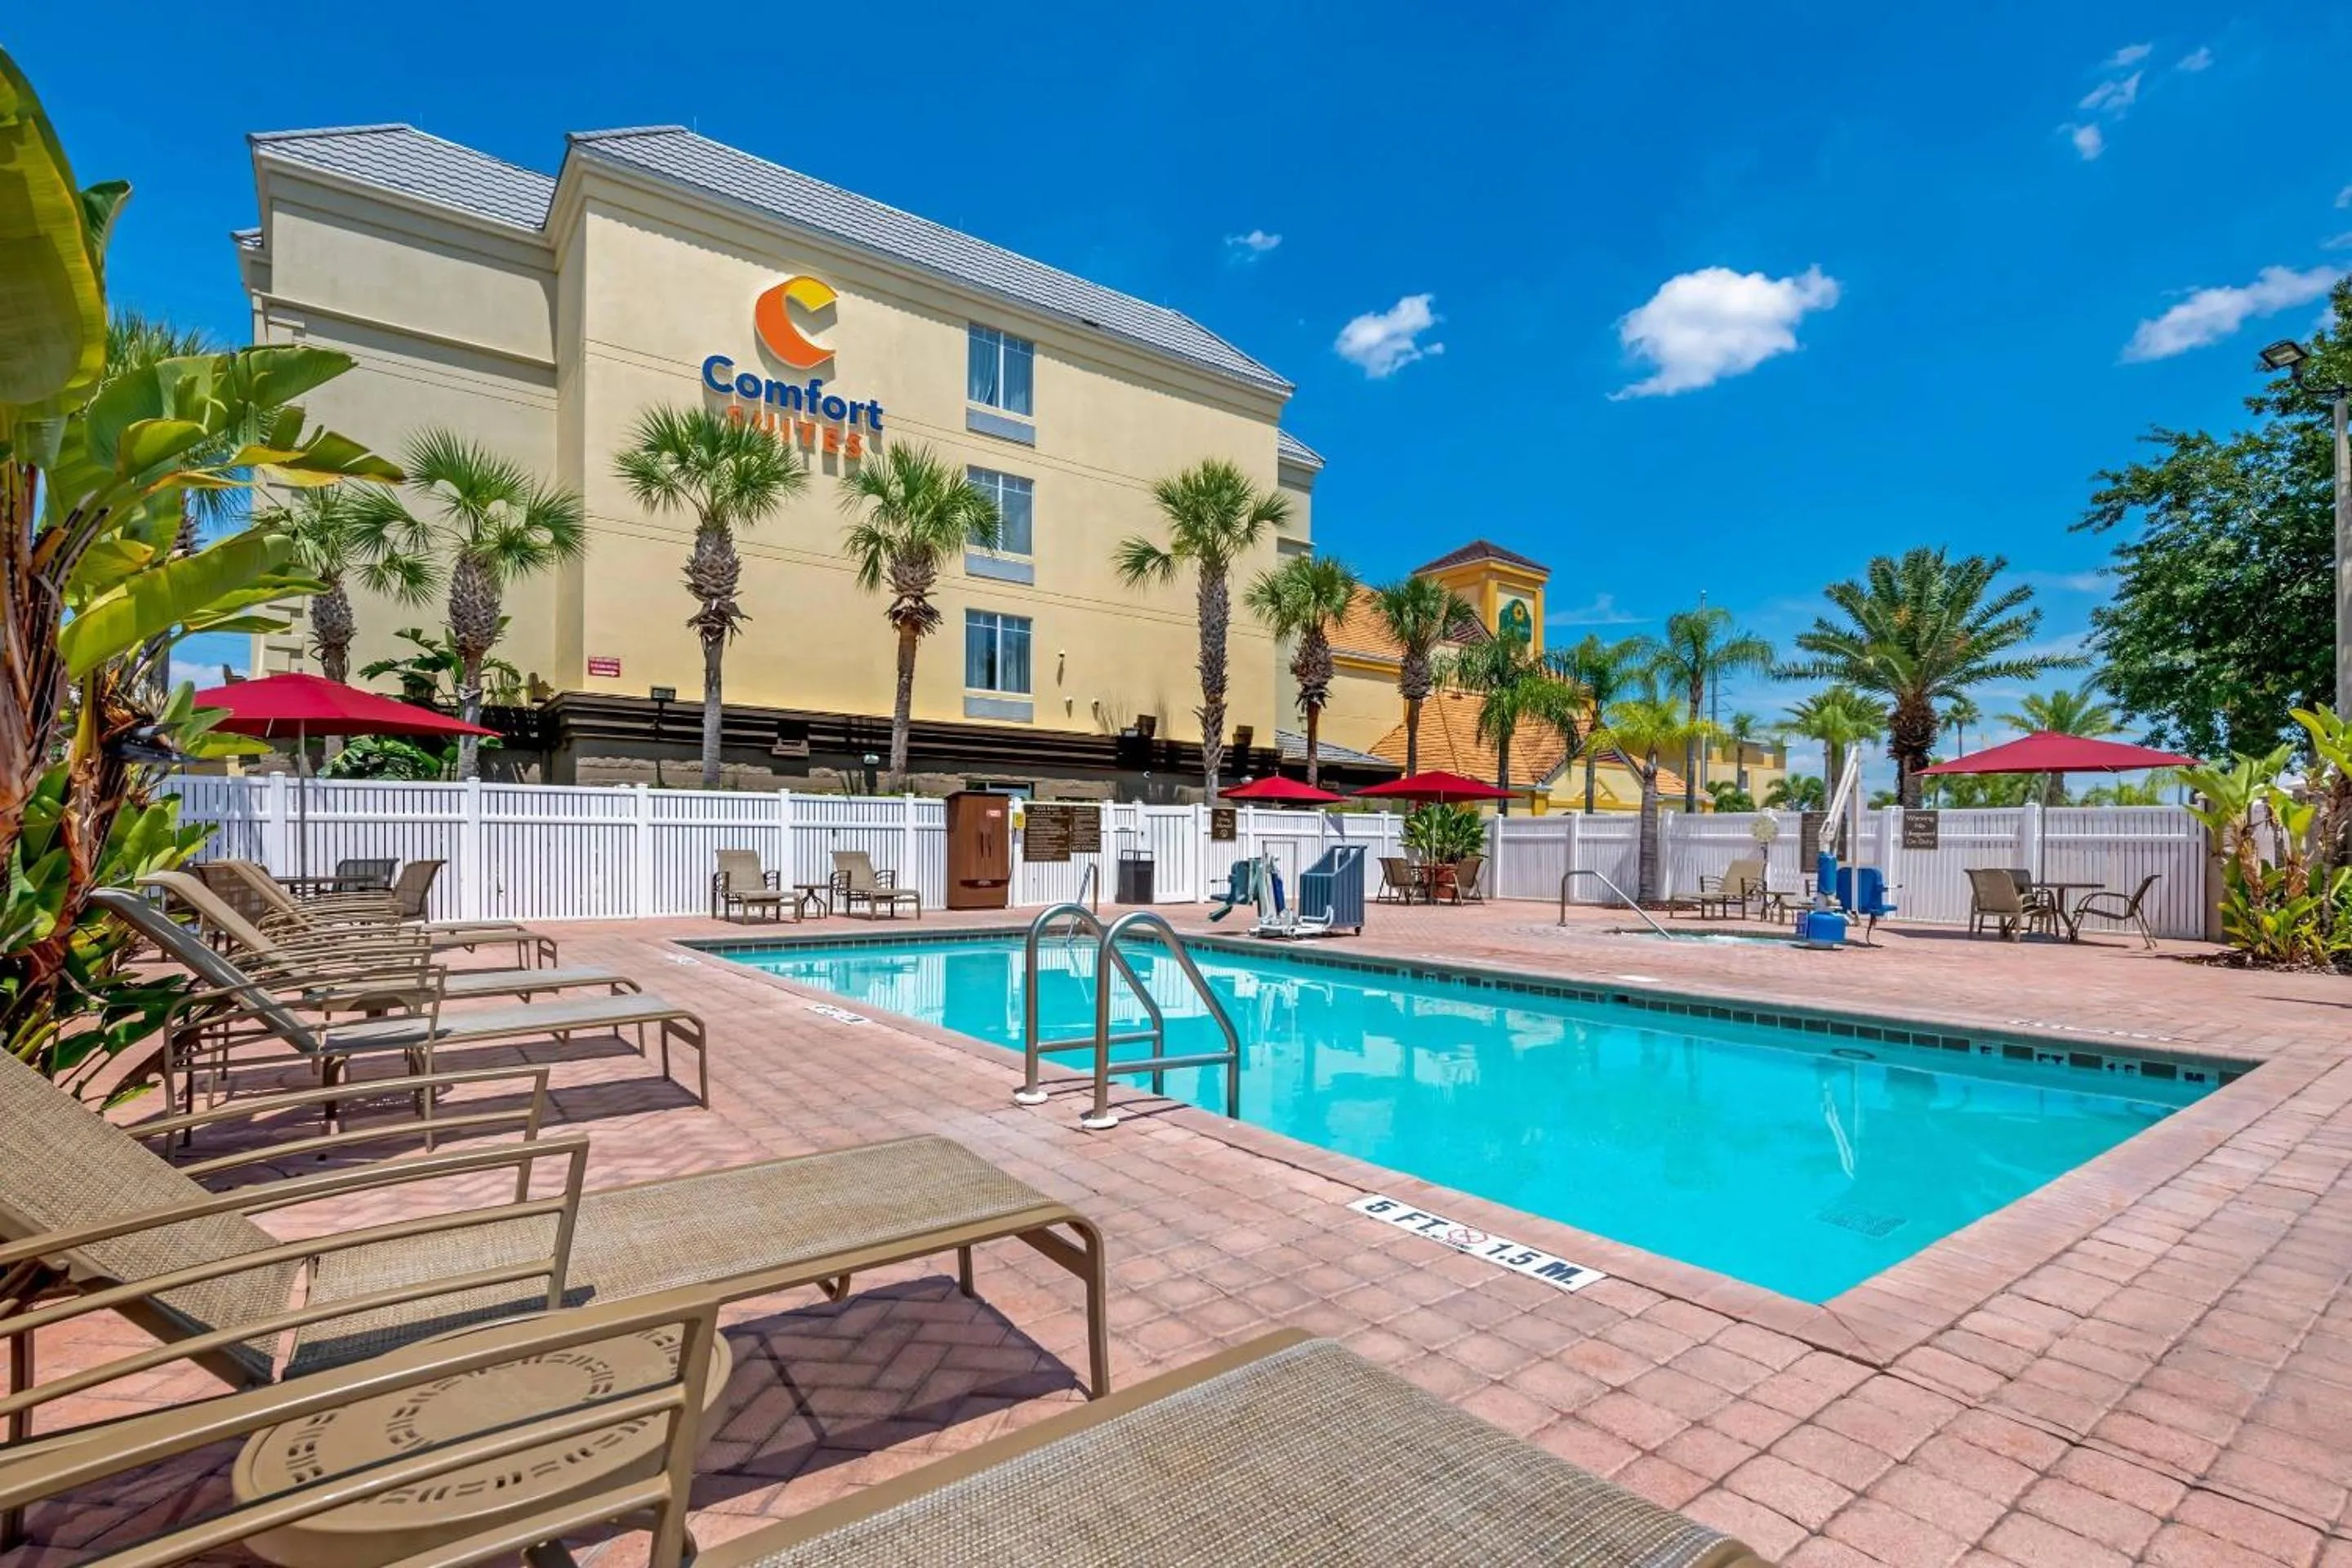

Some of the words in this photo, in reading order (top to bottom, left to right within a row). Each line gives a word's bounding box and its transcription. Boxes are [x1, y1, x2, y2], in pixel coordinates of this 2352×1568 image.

[702, 354, 884, 431] Comfort
[726, 405, 862, 459] SUITES
[1486, 1243, 1542, 1265] 1.5
